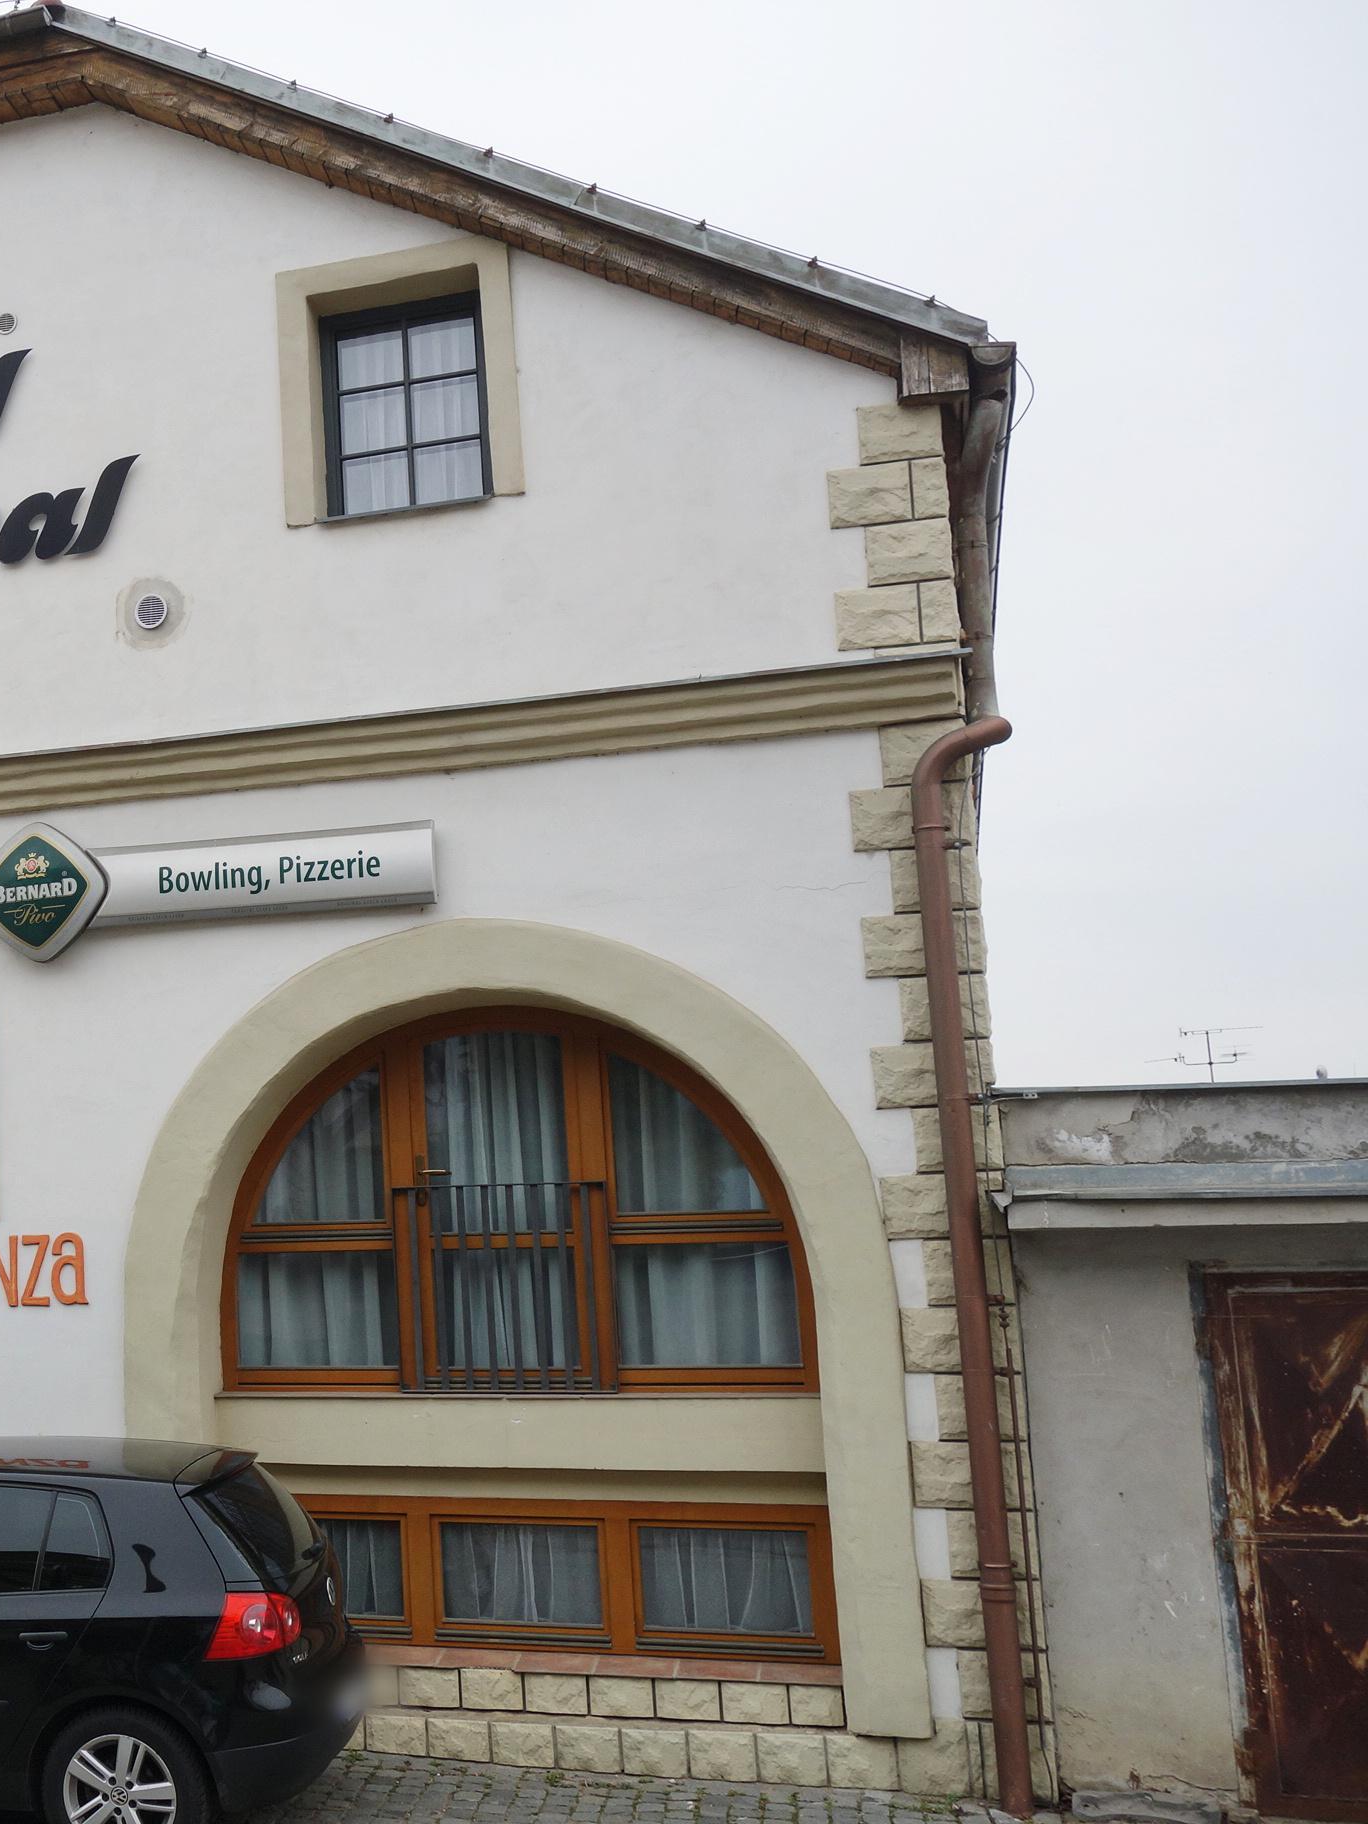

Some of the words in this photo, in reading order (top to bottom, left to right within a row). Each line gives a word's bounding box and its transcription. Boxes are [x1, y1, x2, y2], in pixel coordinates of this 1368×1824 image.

[158, 861, 271, 894] Bowling,
[279, 850, 381, 884] Pizzerie
[13, 903, 56, 926] Pivo
